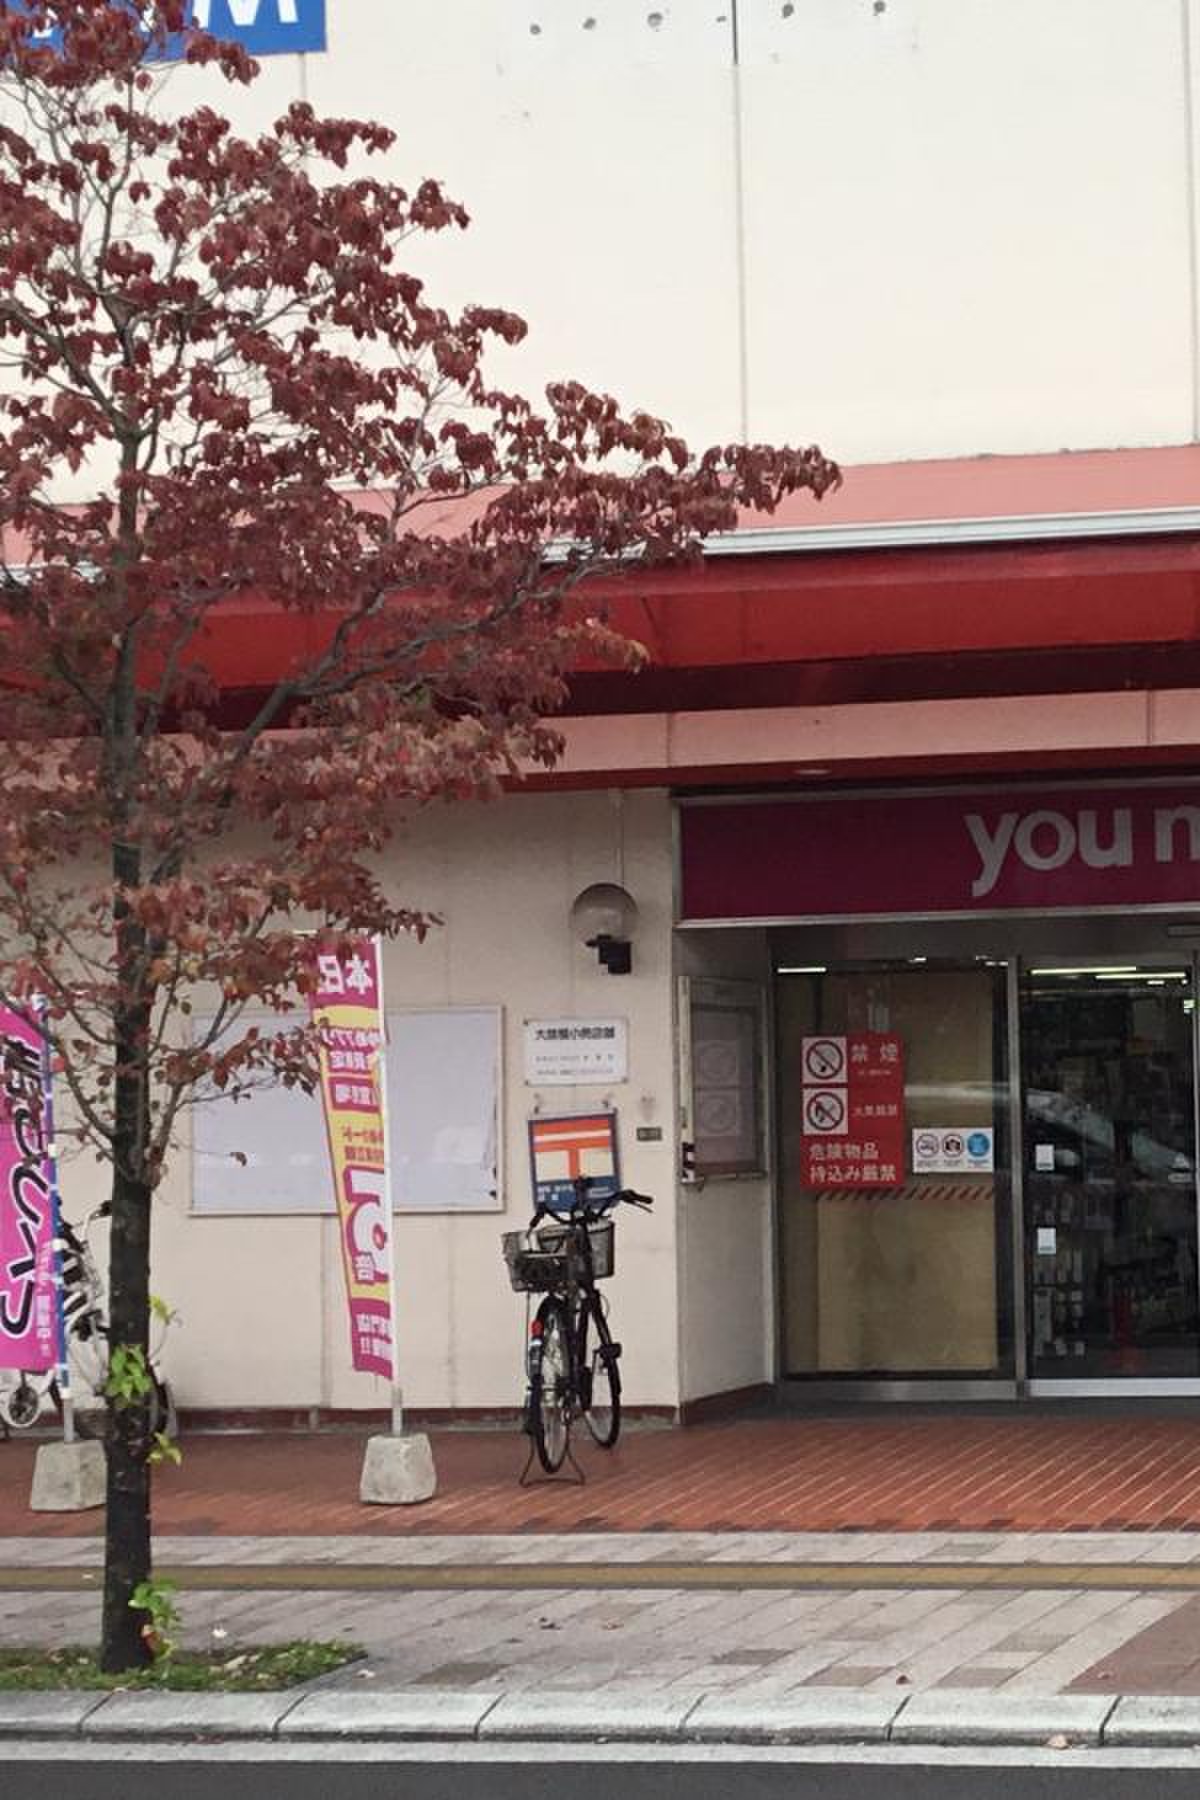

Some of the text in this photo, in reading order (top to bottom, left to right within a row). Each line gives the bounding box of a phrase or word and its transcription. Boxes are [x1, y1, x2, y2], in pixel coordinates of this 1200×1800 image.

[963, 808, 1134, 897] you
[851, 1043, 897, 1063] 禁煙
[809, 1142, 879, 1160] 危険物品
[810, 1164, 896, 1183] 持込み厳禁
